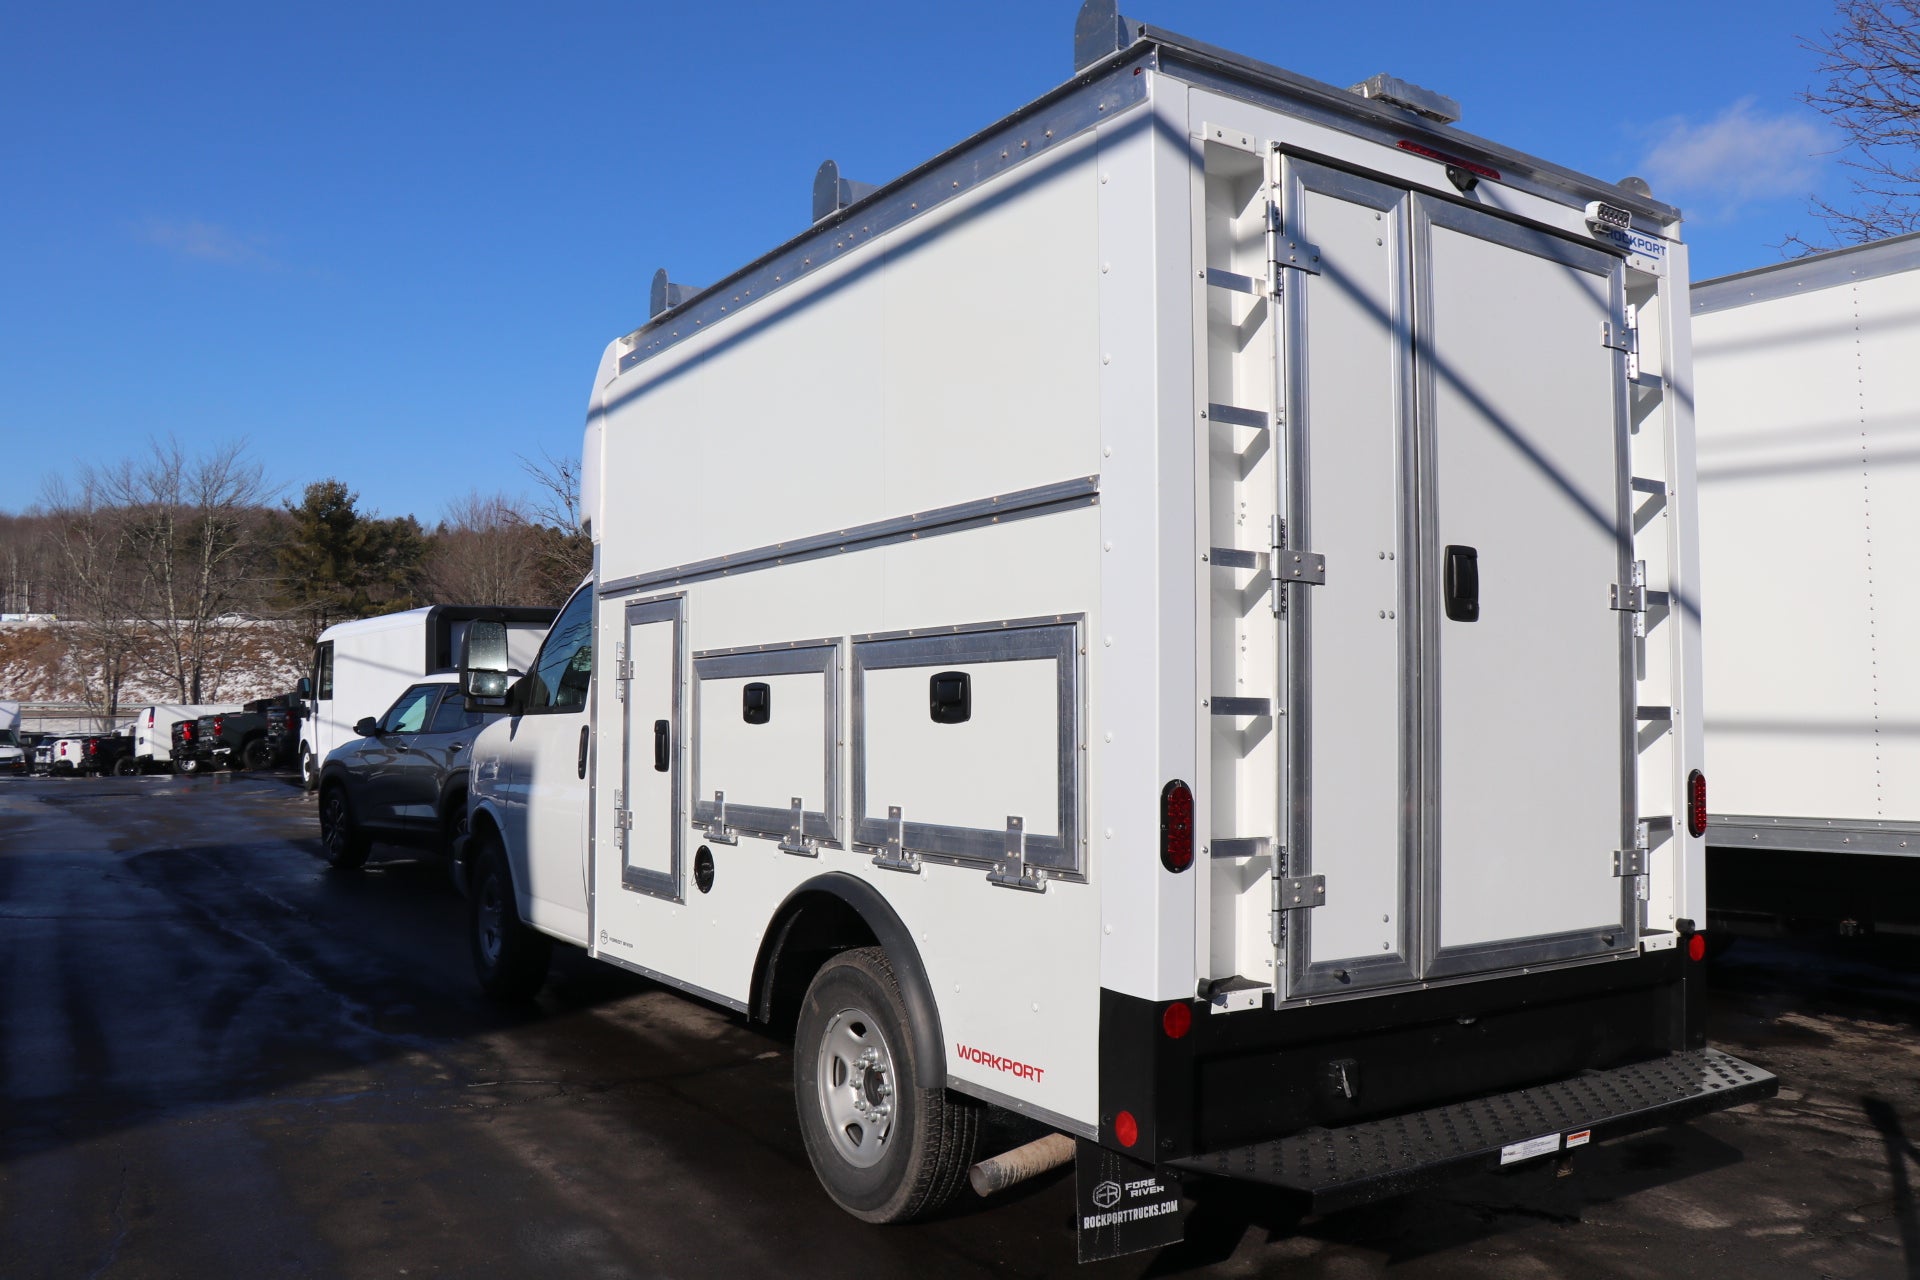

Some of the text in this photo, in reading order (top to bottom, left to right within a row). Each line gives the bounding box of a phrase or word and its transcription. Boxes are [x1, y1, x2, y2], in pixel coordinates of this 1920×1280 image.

[957, 1043, 1044, 1083] WORKPORT
[1125, 1178, 1156, 1190] FORE
[1130, 1186, 1164, 1197] RIVER
[1083, 1200, 1178, 1229] ROCKPORTTRUCKS.COM
